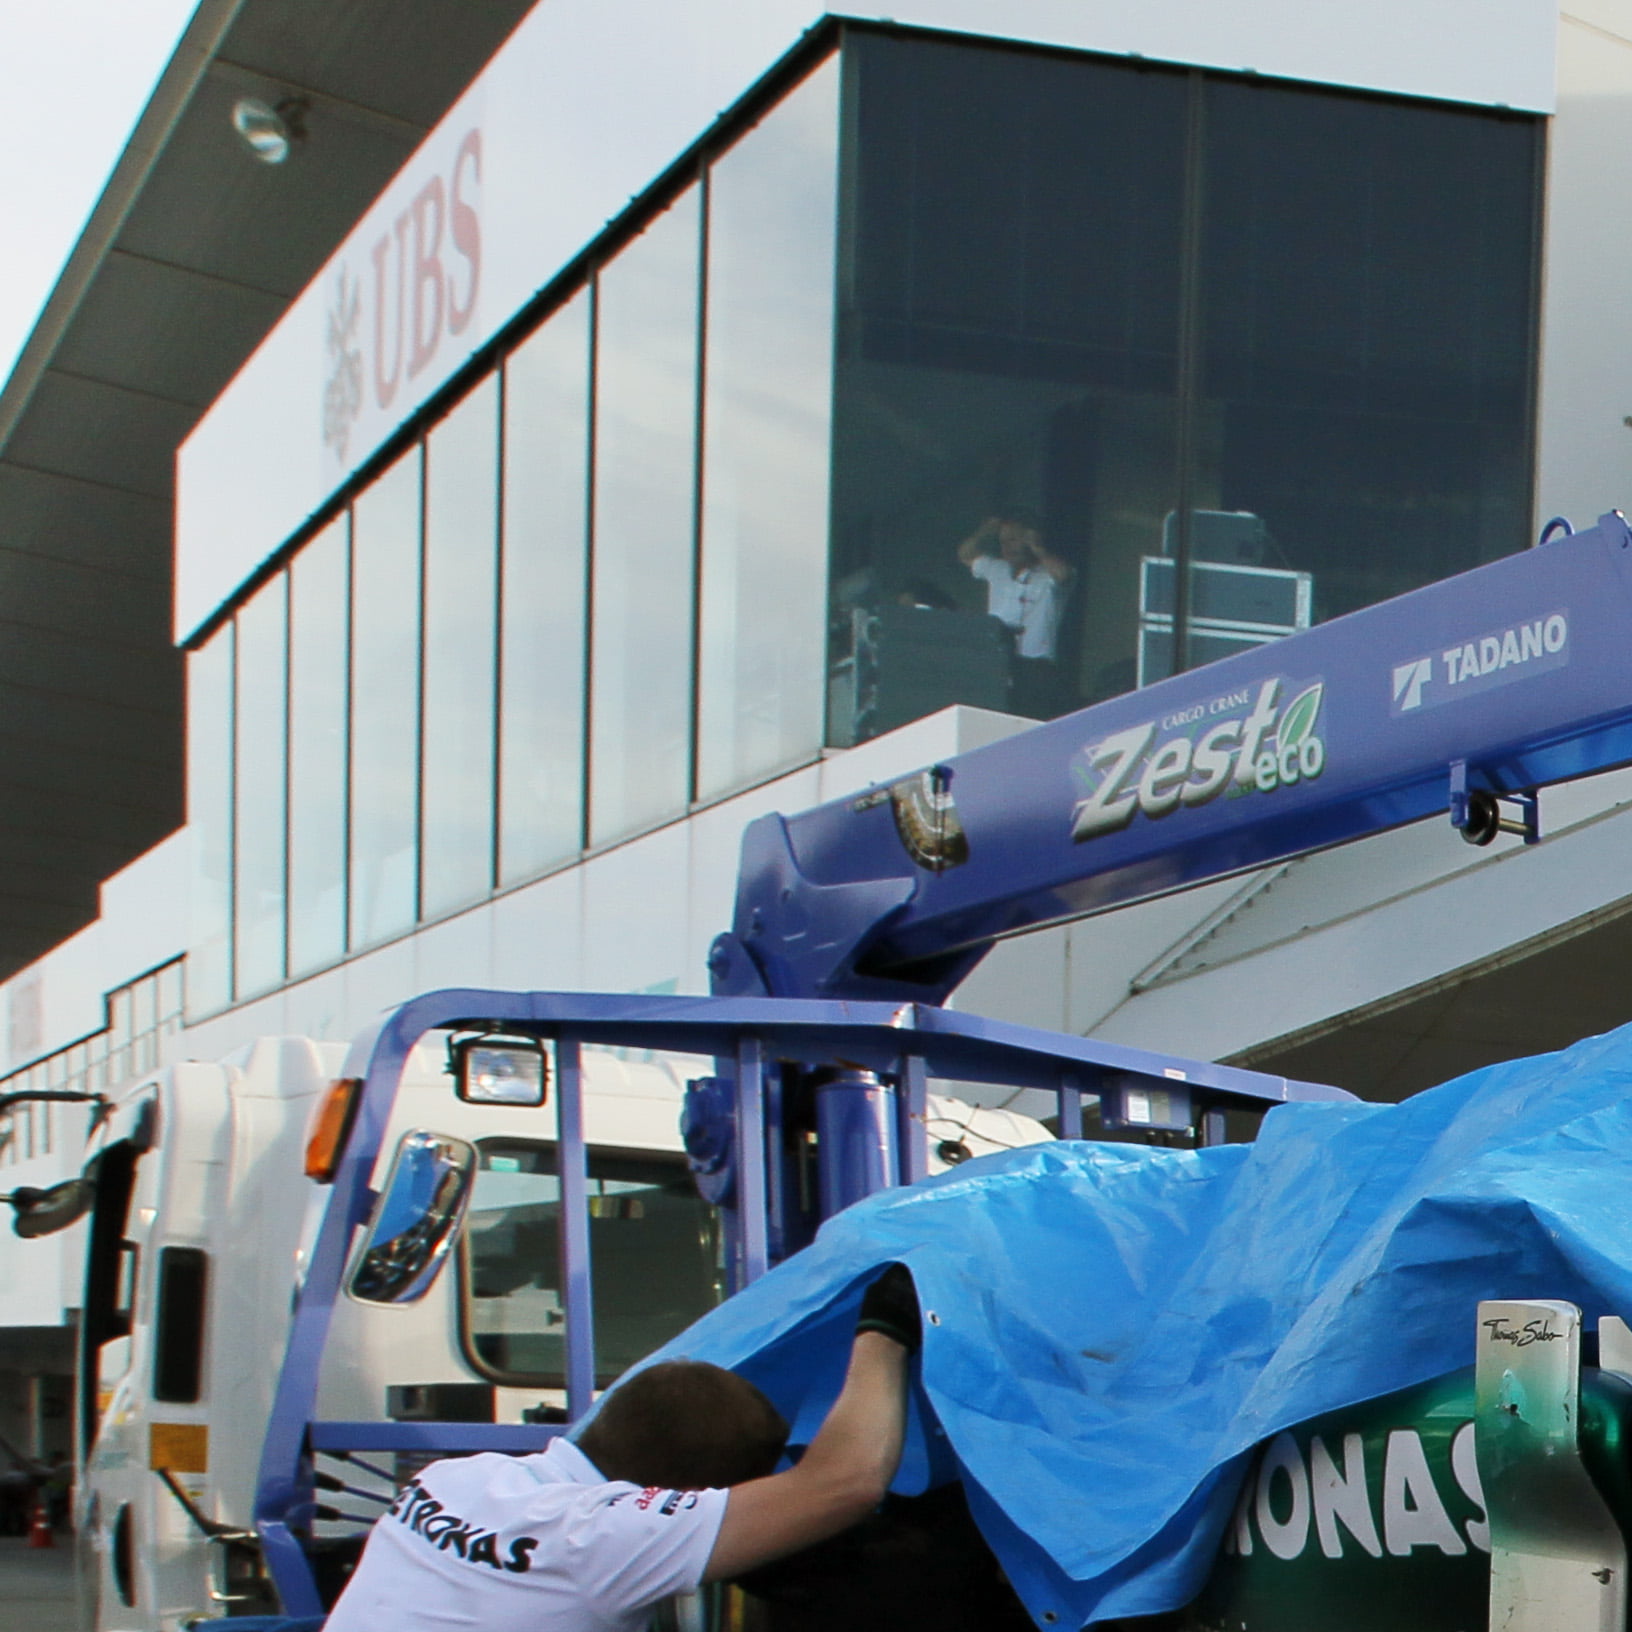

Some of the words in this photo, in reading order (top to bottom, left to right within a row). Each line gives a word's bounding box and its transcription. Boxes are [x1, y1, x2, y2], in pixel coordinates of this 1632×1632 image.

[371, 127, 482, 411] UBS
[1443, 614, 1567, 685] TADANO
[1161, 704, 1205, 731] CARGO
[1208, 689, 1250, 715] CRANE
[1071, 677, 1281, 845] Zest
[1254, 735, 1325, 794] eco
[1516, 1319, 1563, 1347] Sabo
